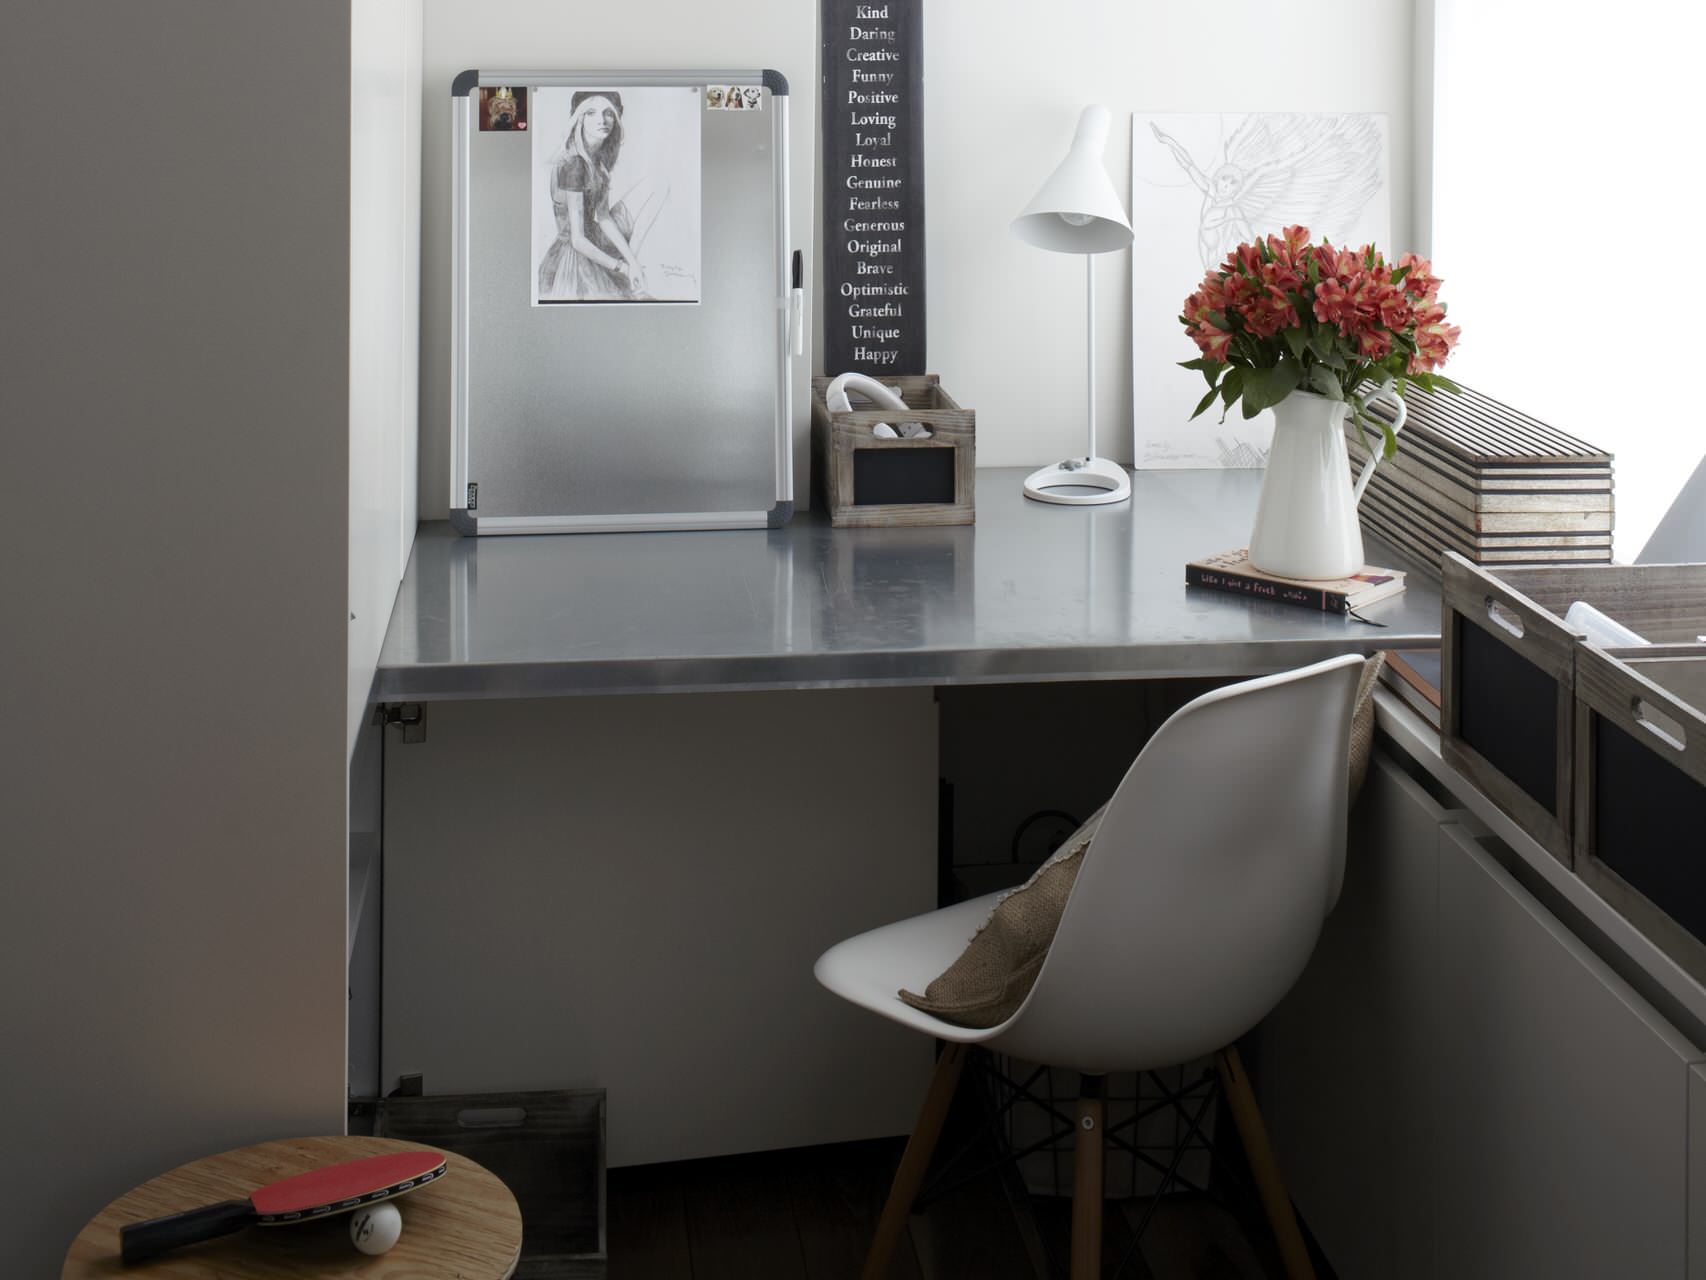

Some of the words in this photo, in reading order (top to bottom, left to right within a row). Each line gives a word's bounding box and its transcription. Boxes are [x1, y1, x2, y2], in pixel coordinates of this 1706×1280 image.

[856, 5, 889, 19] Kind
[850, 26, 895, 44] Daring
[846, 47, 900, 61] Creative
[852, 69, 894, 86] Funny
[848, 90, 899, 104] Positive
[851, 112, 896, 129] Loving
[856, 132, 891, 150] Loyal
[850, 154, 897, 168] Honest
[846, 175, 902, 189] Genuine
[849, 196, 900, 210] Fearless
[844, 218, 905, 232] Generous
[847, 239, 902, 257] Original
[856, 261, 894, 275] Brave
[840, 282, 909, 300] Optimistic
[848, 303, 902, 318] Grateful
[851, 325, 900, 343] Unique
[854, 346, 898, 364] Happy
